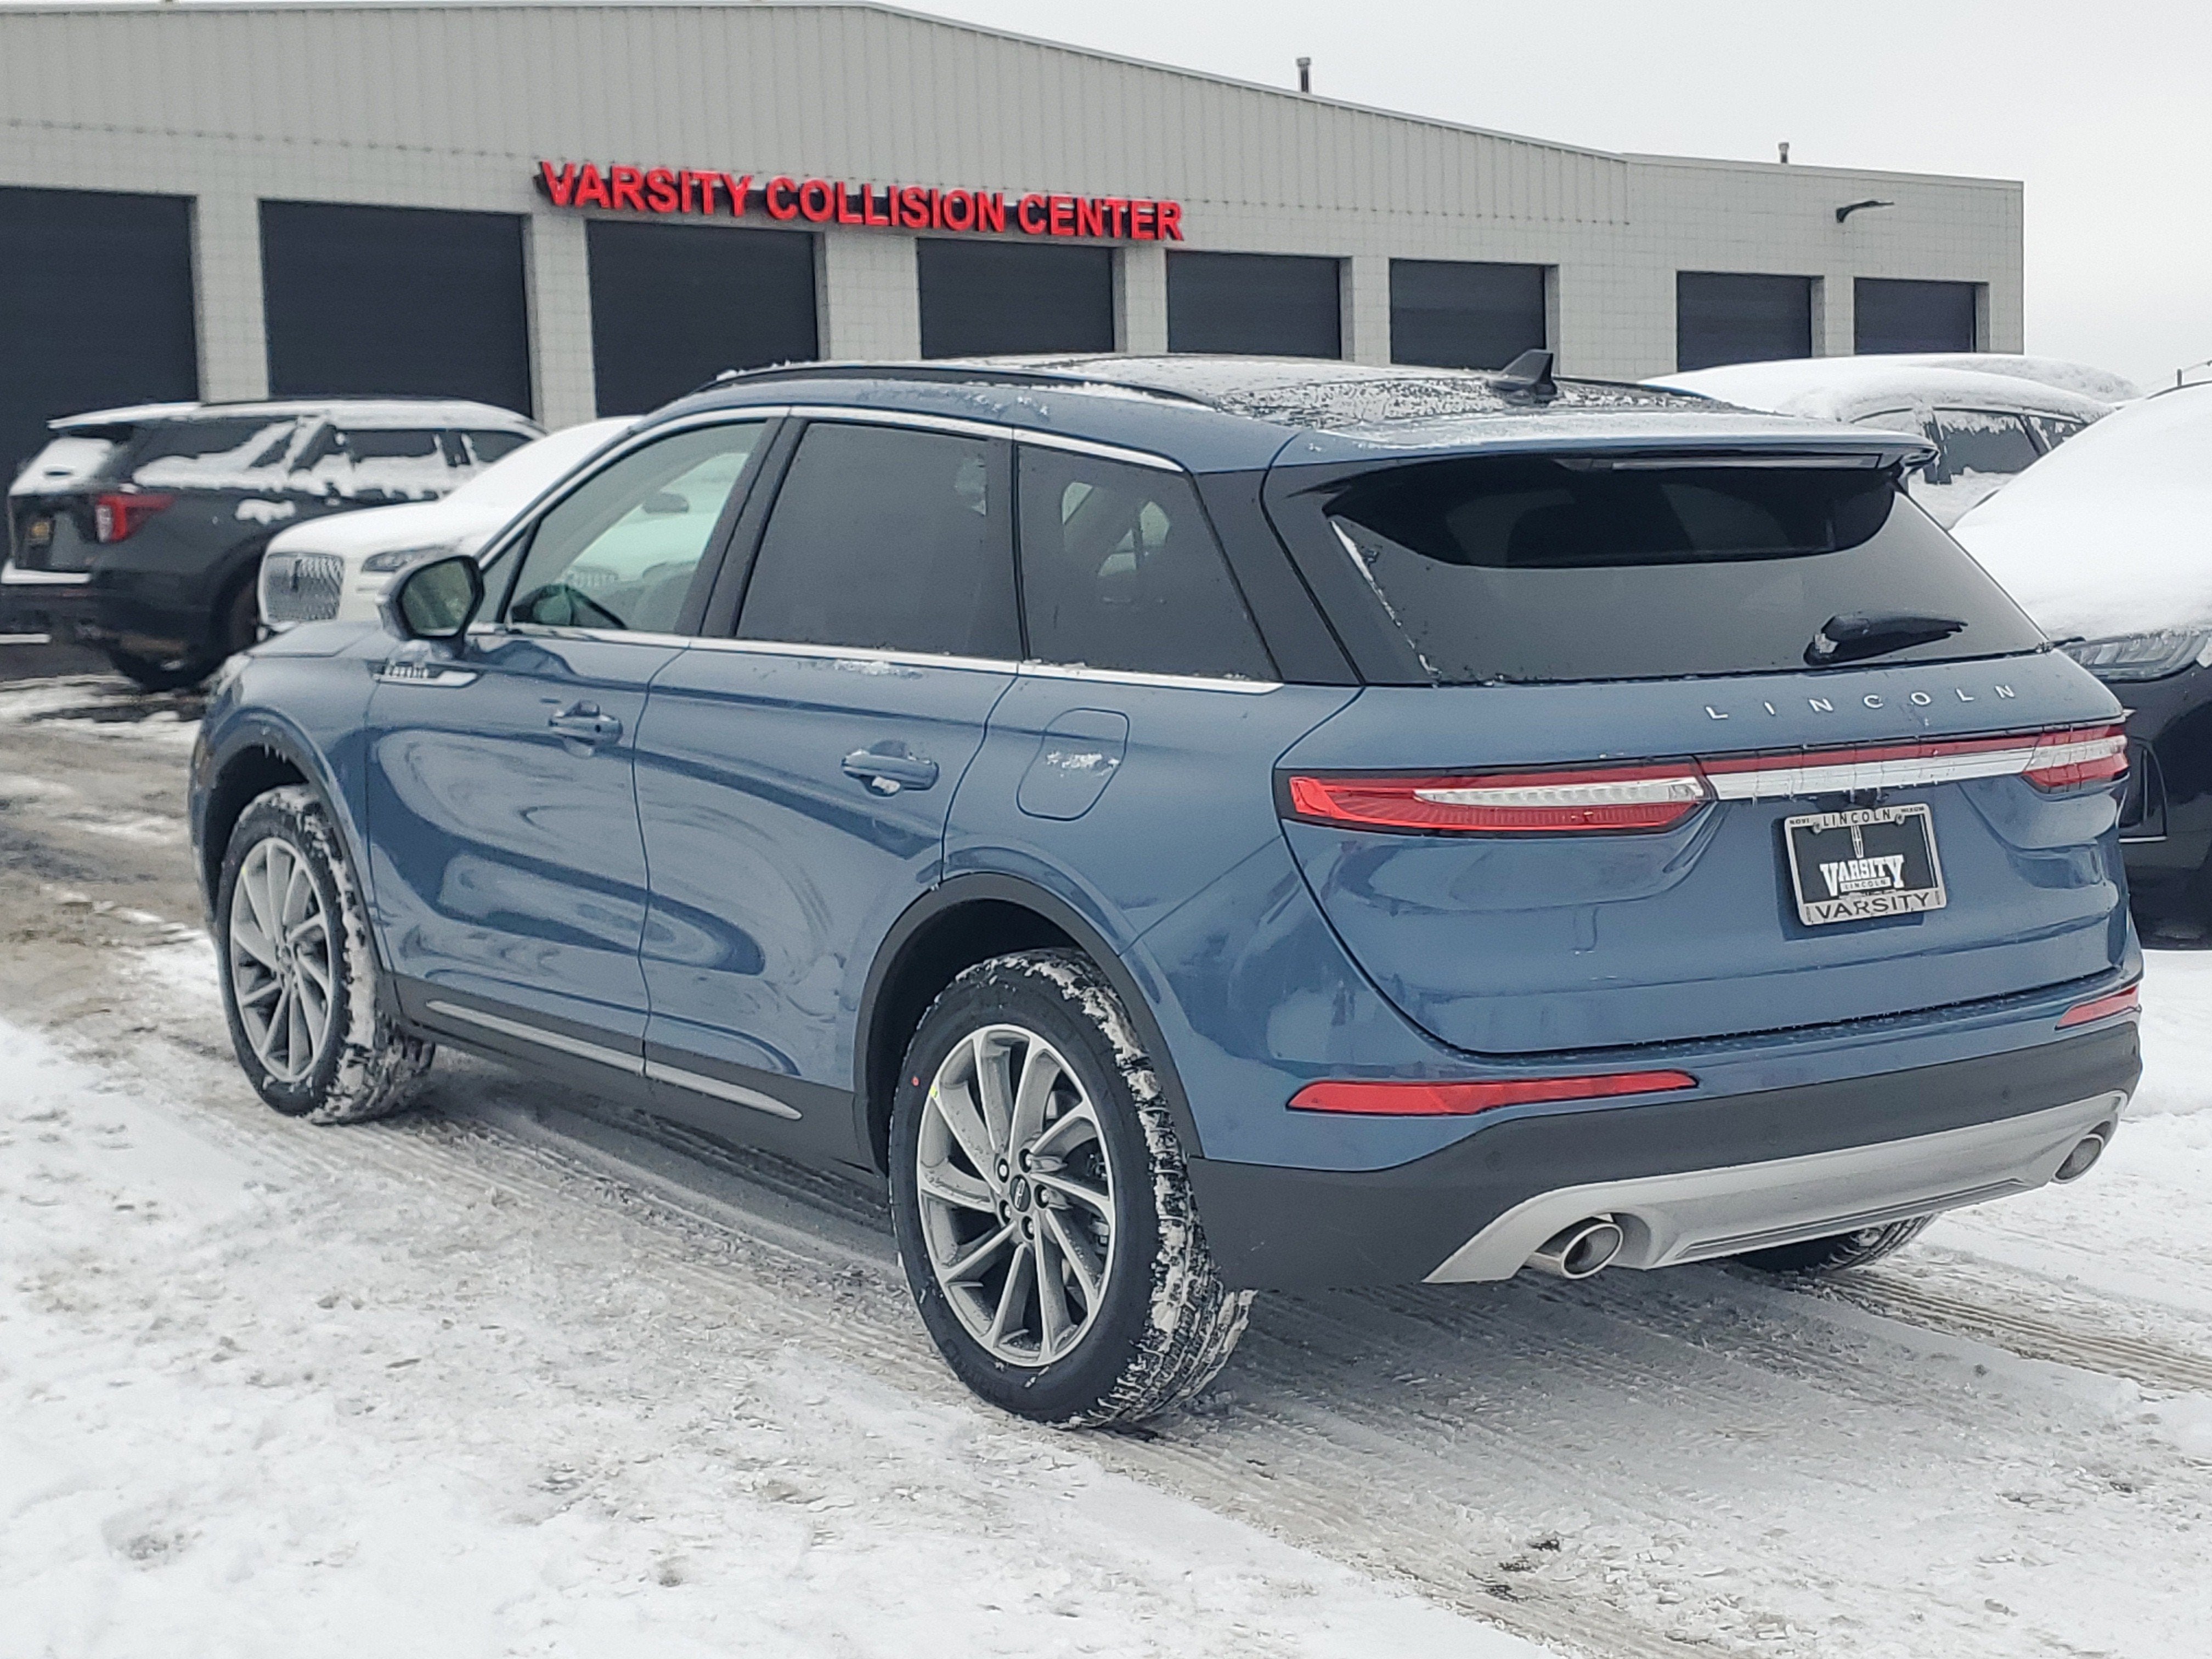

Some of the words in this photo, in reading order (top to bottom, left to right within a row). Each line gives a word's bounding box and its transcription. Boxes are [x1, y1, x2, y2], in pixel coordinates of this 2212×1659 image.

[540, 159, 752, 217] VARSITY
[767, 176, 1006, 234] COLLISION
[1018, 193, 1185, 242] CENTER
[1706, 684, 2016, 720] LINCOLN
[1822, 809, 1891, 827] LINCOLN
[1819, 854, 1904, 897] VARSITY
[1845, 879, 1887, 890] LINCOLN
[1815, 891, 1930, 919] VARSITY
